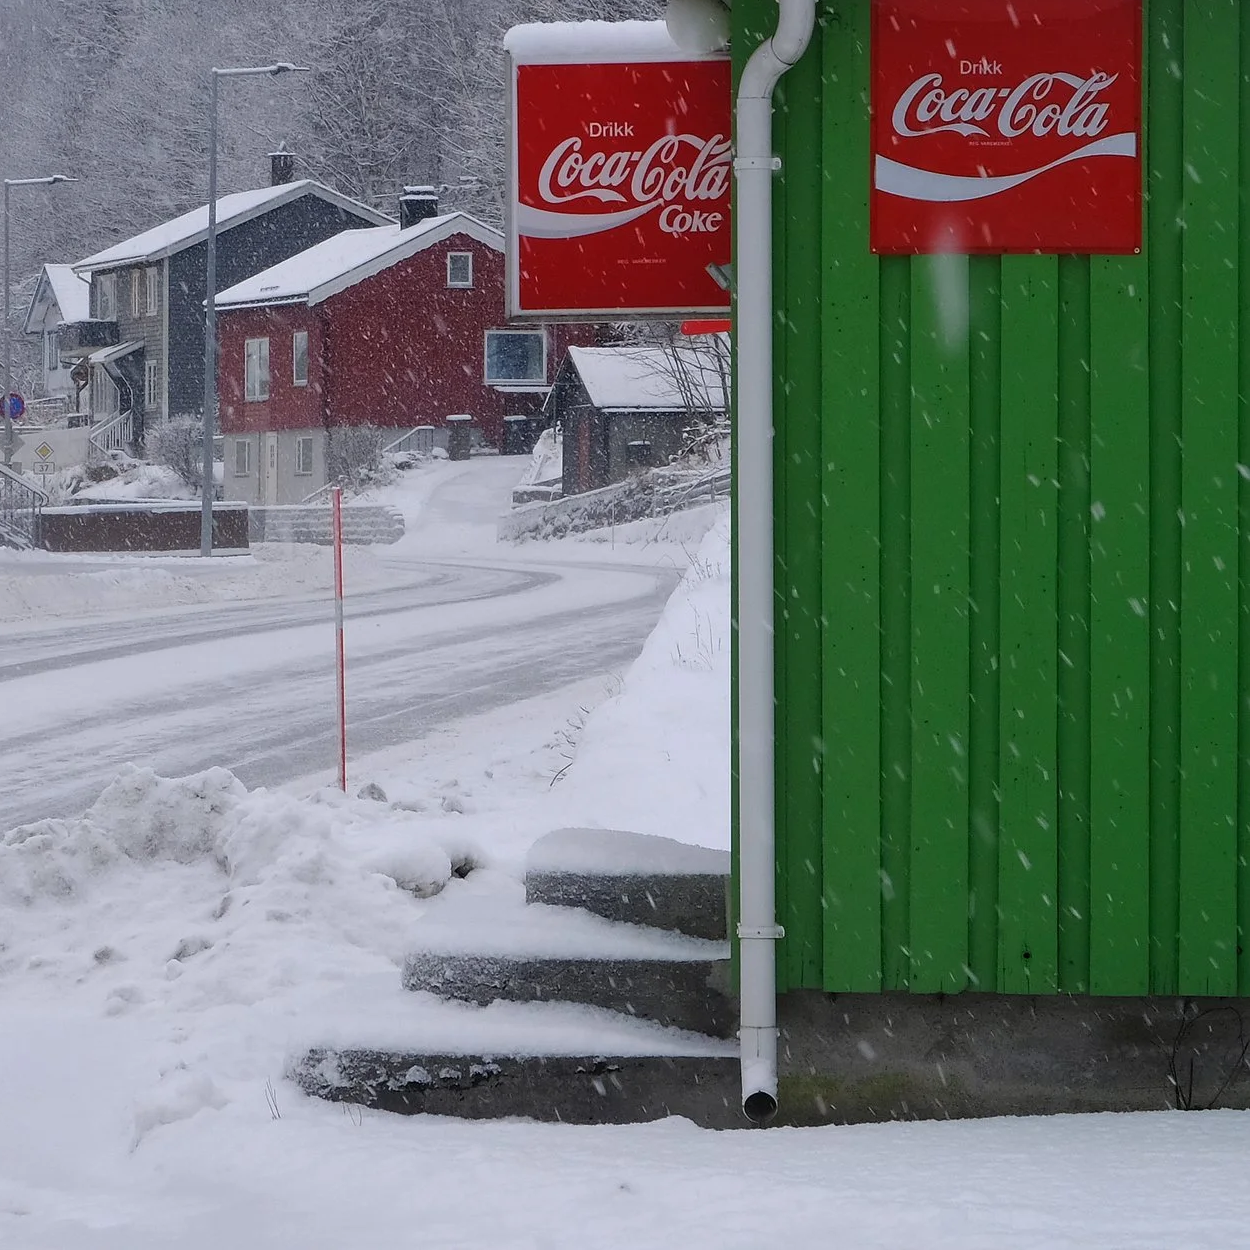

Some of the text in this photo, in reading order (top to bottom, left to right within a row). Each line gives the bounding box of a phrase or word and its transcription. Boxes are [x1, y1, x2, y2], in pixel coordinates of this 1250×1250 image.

[960, 60, 1002, 75] Drikk
[892, 72, 1119, 137] Coca-Cola
[589, 122, 634, 137] Drikk
[538, 134, 730, 203] Coca-Cola
[658, 204, 723, 233] Coke
[39, 464, 49, 472] 37
